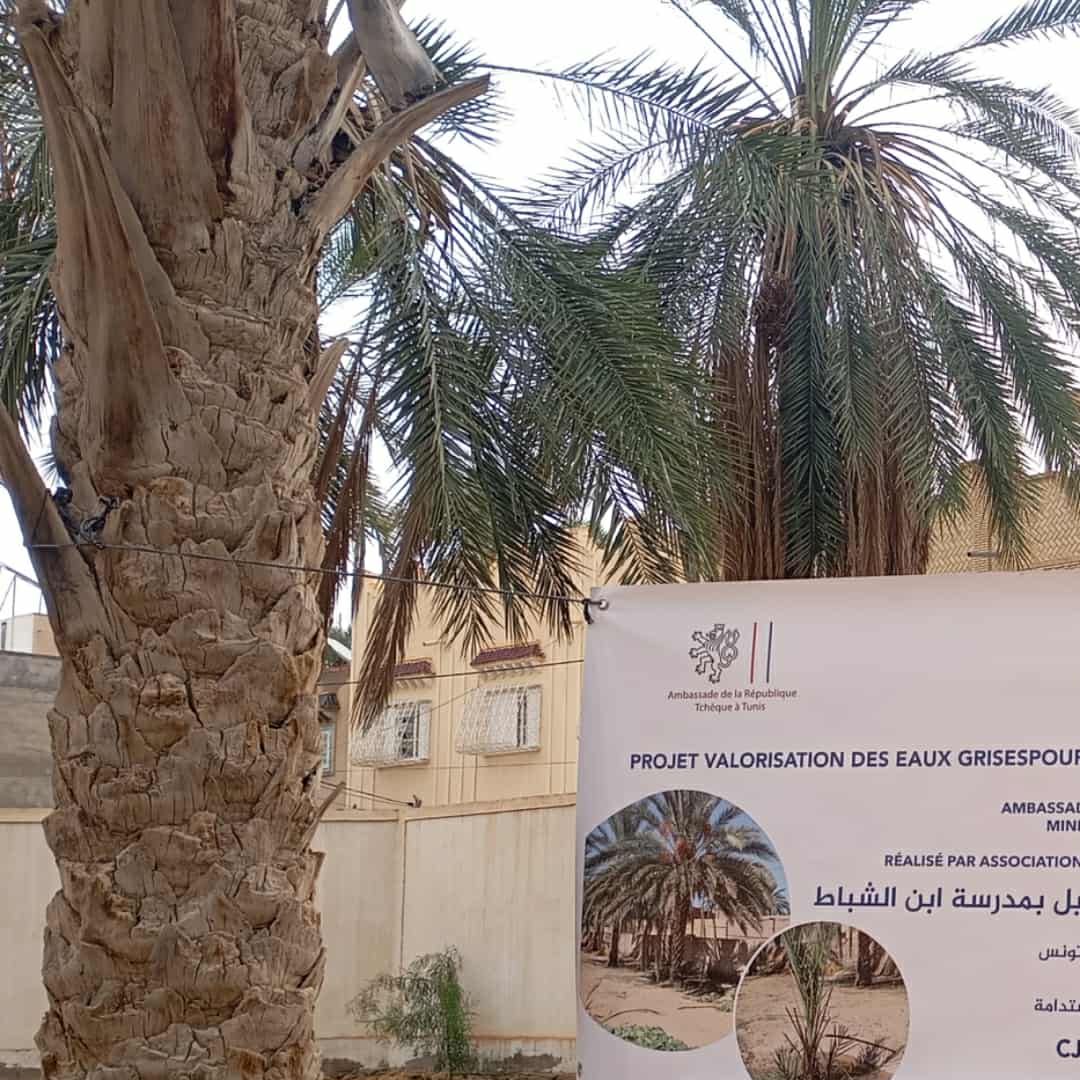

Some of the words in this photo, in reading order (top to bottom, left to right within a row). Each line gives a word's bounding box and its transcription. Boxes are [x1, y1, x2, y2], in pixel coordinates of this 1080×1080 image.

[667, 689, 719, 701] Ambassade
[720, 689, 733, 700] de
[734, 689, 743, 699] la
[744, 688, 798, 701] République
[695, 703, 734, 714] Tchèque
[734, 702, 741, 712] à
[742, 702, 766, 713] Tunis
[630, 753, 700, 770] PROJET
[704, 751, 845, 769] VALORISATION
[850, 751, 889, 768] DES
[896, 750, 952, 767] EAUX
[884, 852, 945, 868] RÉALISÉ
[947, 854, 977, 868] PAR
[812, 881, 897, 914] الشباط
[904, 886, 943, 915] ابن
[951, 887, 1045, 917] بمدرسة
